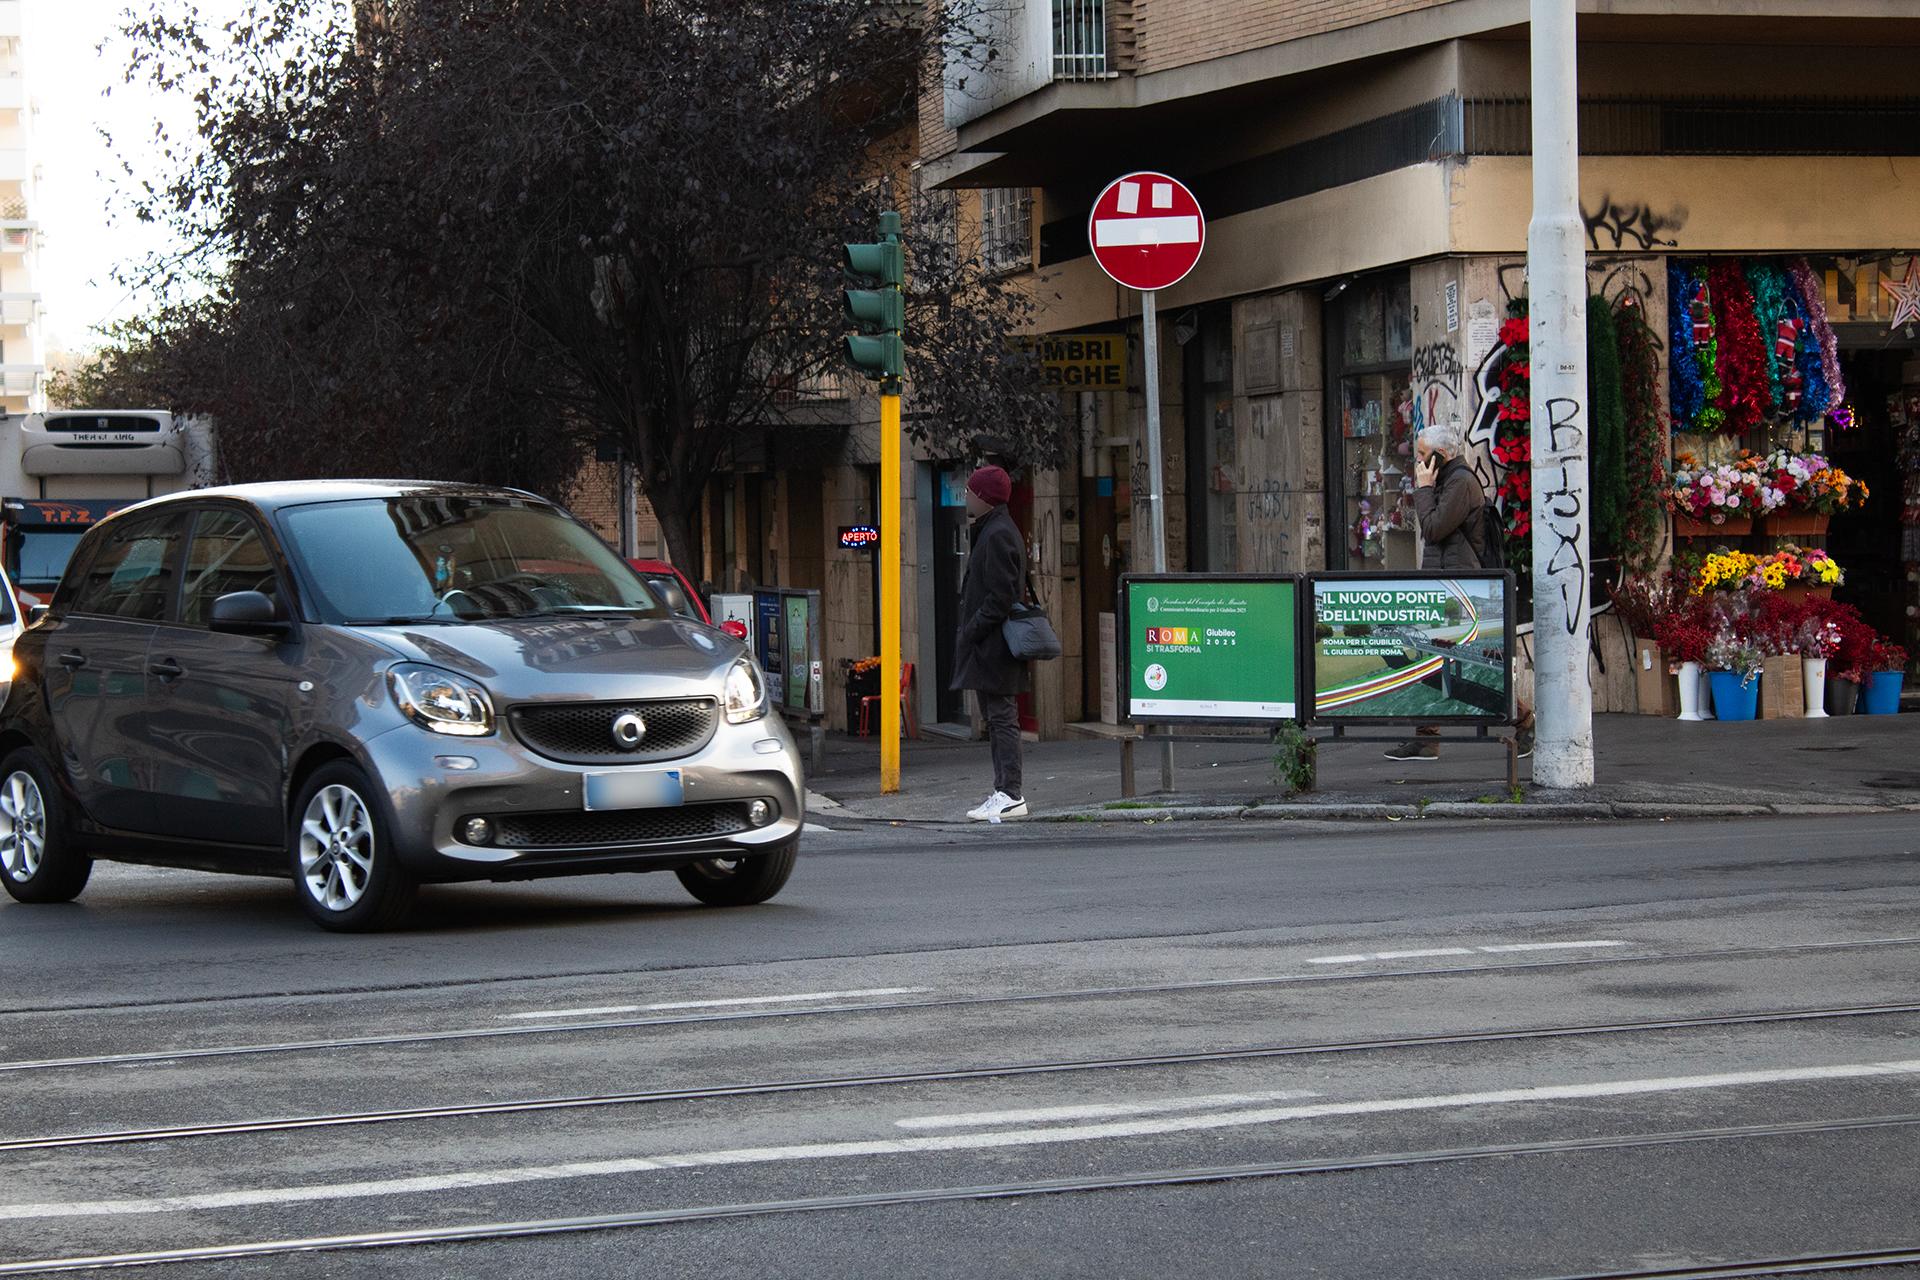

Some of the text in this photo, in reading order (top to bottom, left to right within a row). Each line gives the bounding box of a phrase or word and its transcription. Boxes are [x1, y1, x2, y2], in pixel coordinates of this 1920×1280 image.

[842, 532, 878, 542] APERTO
[1323, 592, 1446, 604] IL NUOVO PONTE
[1323, 609, 1445, 622] DELL'INDUSTRIA.
[1148, 629, 1199, 642] ROMA
[1206, 629, 1236, 637] Giubileo
[1146, 645, 1202, 653] SI TRASFORMA
